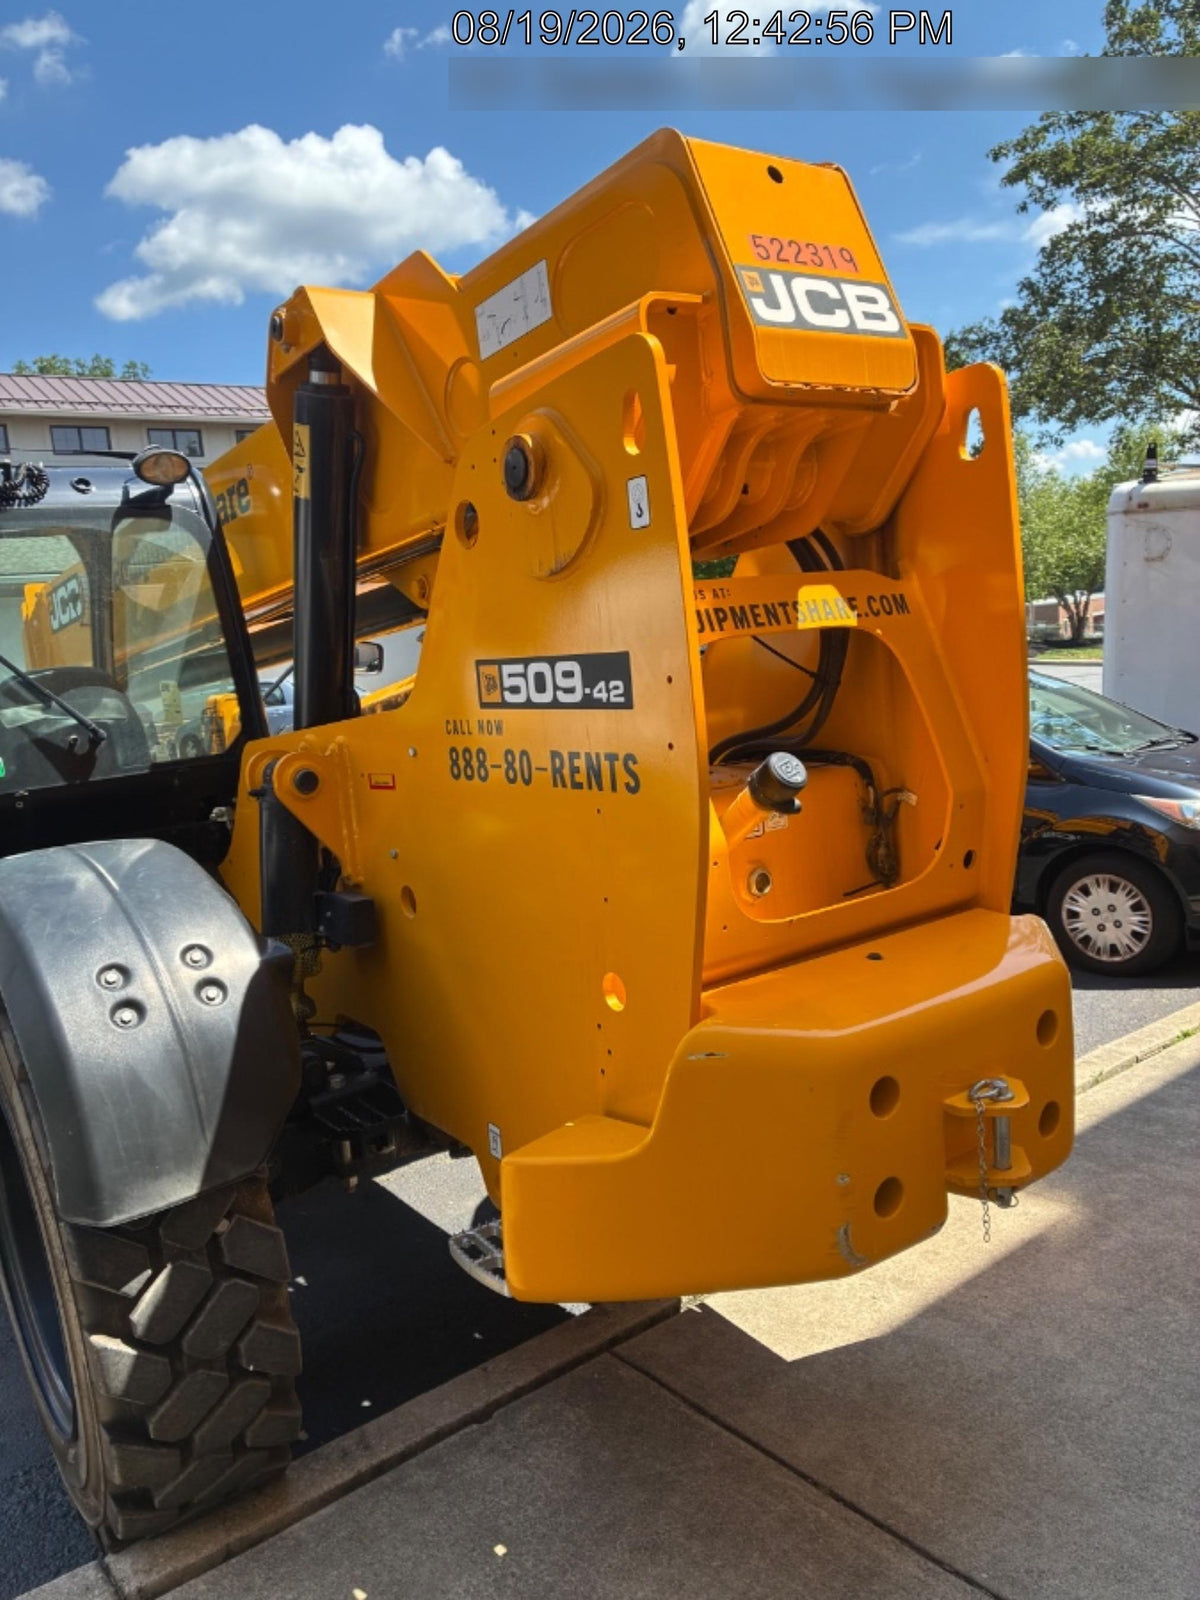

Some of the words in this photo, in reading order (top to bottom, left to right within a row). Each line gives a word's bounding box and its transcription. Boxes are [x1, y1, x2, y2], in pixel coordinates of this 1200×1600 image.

[751, 234, 859, 273] 522319
[751, 273, 900, 333] JCB
[712, 587, 731, 600] AT:
[501, 660, 626, 703] 509-42
[446, 719, 473, 736] CALL
[477, 720, 504, 736] NOW
[449, 745, 641, 795] 888-80-RENTS
